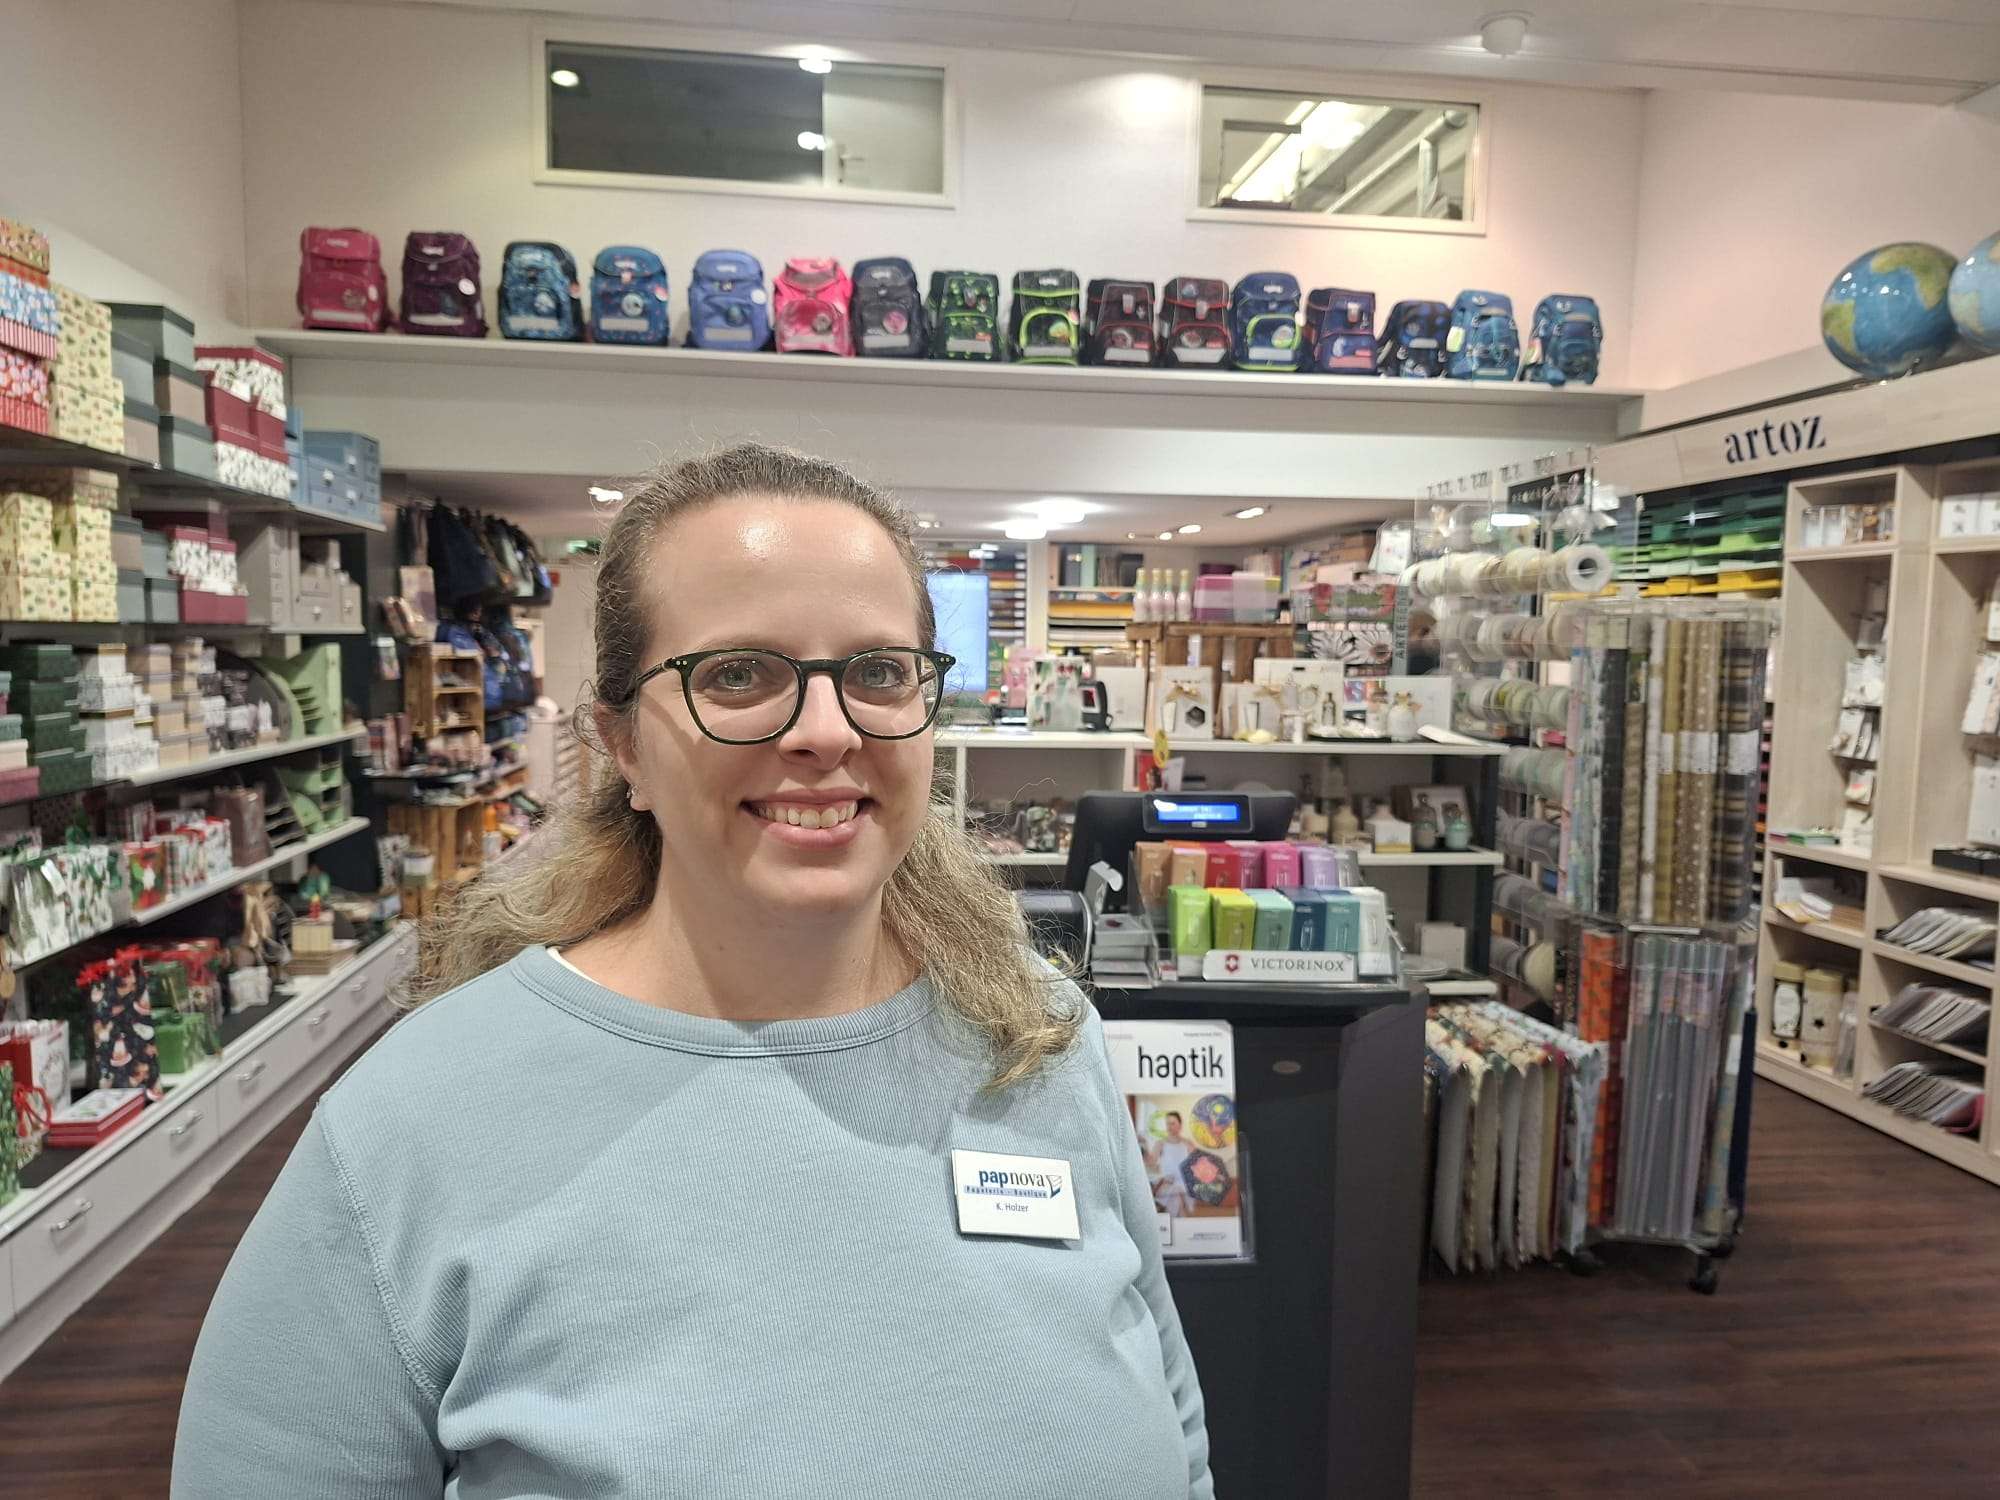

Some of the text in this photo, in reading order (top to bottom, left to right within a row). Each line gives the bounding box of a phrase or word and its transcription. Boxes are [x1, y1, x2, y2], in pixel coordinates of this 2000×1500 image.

[1725, 415, 1826, 463] artoz
[1251, 958, 1344, 971] VICTORINOX
[1138, 1045, 1223, 1087] haptik
[979, 1170, 1045, 1188] papnova
[1005, 1203, 1029, 1212] Holzer
